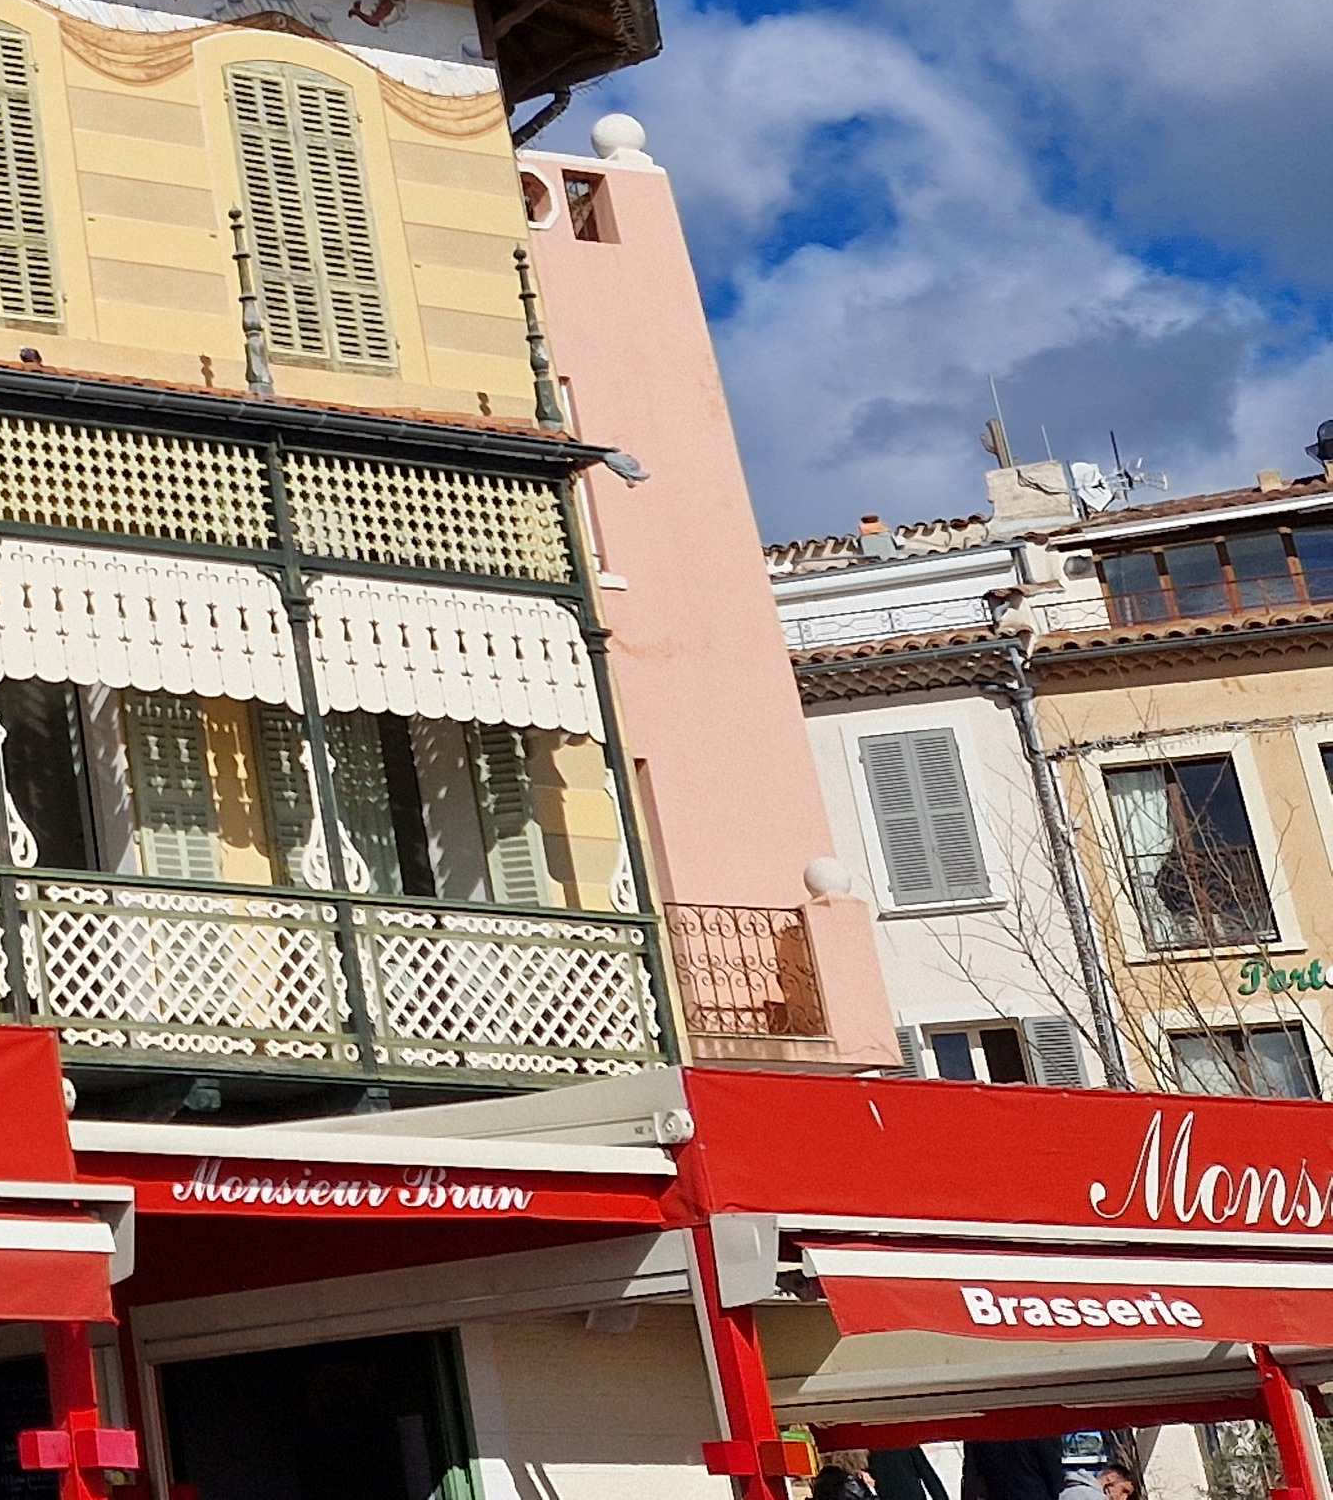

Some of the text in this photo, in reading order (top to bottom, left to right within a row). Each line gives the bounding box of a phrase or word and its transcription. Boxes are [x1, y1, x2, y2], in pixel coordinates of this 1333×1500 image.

[172, 1156, 535, 1212] Monsieur Brun
[958, 1285, 1204, 1328] Brasserie
